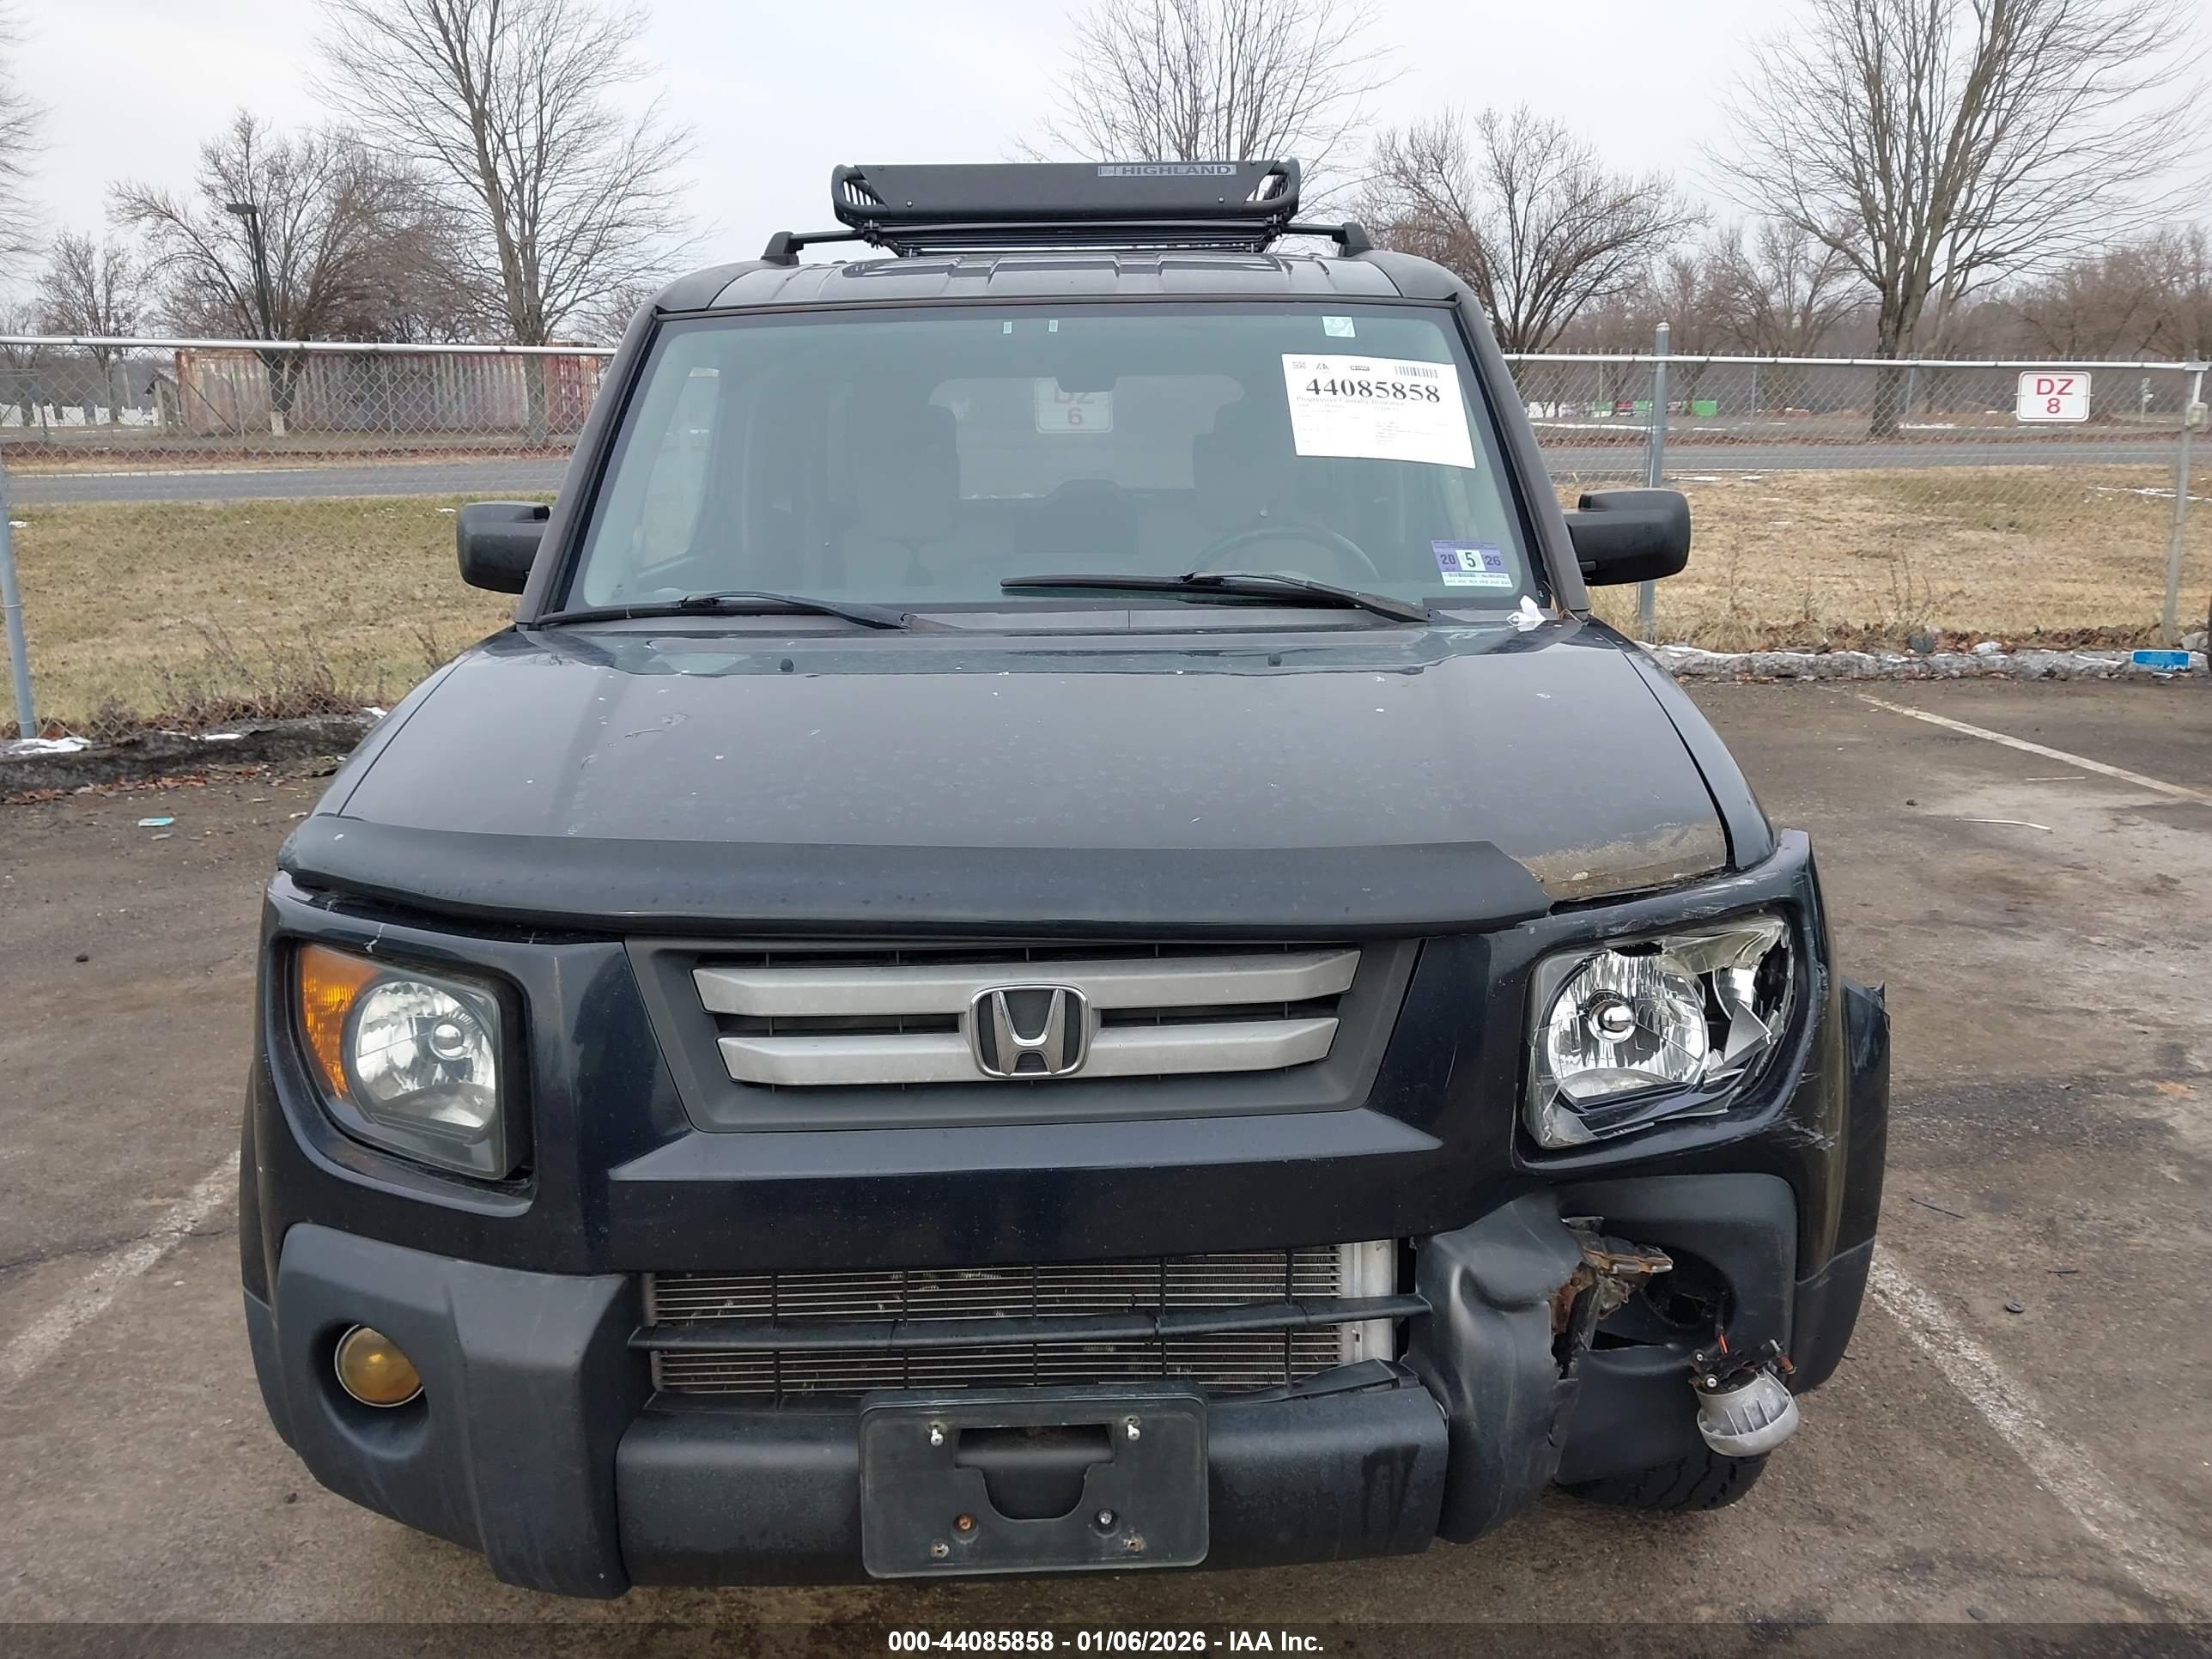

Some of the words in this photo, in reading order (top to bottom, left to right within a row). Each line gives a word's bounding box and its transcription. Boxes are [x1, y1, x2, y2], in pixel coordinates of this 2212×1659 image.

[1121, 166, 1231, 175] HIGHLAND
[1305, 378, 1441, 403] 44085858
[2036, 378, 2074, 396] DZ
[2046, 398, 2061, 414] 8
[1067, 407, 1084, 427] 6
[1440, 554, 1456, 565] 20
[1465, 551, 1476, 568] 5
[1485, 556, 1501, 567] 26
